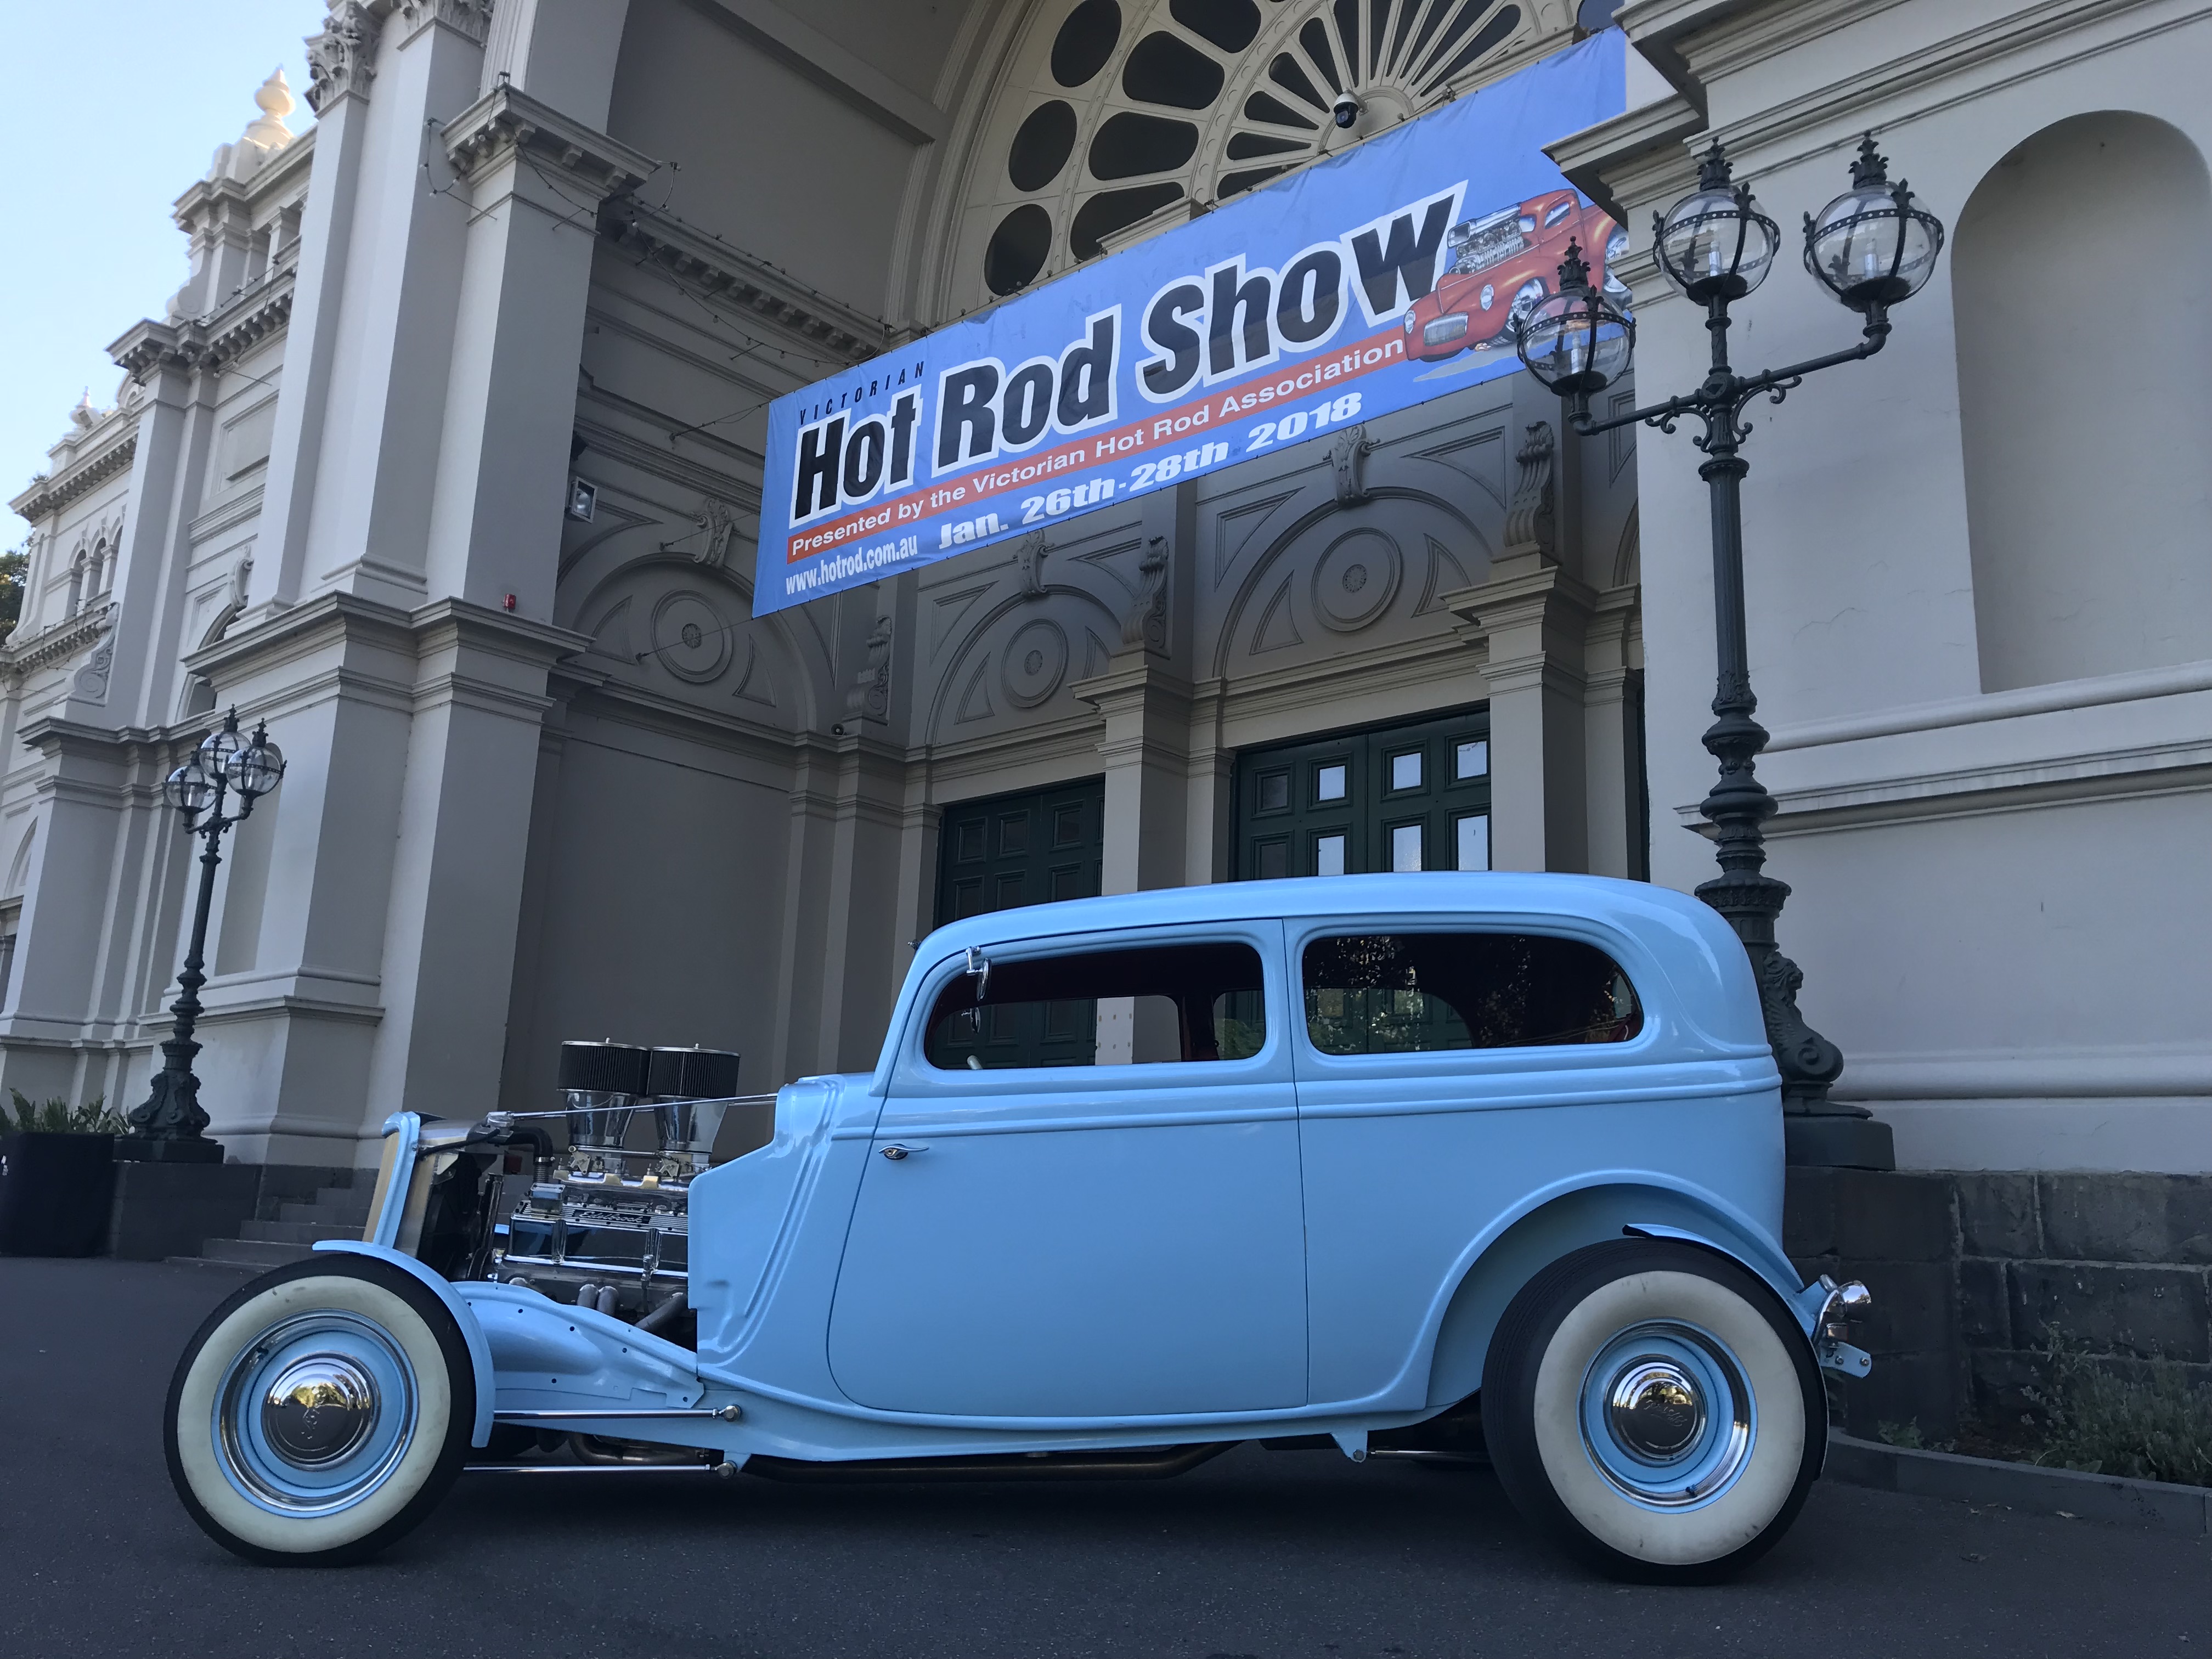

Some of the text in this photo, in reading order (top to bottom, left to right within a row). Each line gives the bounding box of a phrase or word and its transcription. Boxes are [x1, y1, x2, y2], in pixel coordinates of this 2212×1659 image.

[794, 196, 1454, 520] Hot Rod Show
[800, 361, 924, 425] VICTORIAN
[792, 339, 1403, 556] Presented by the Victorian Hot Rod Association
[939, 512, 1009, 549] Jan.
[1245, 392, 1362, 453] 2018
[786, 534, 918, 595] www.hotrod.com.au
[579, 1211, 644, 1223] Edelbrock
